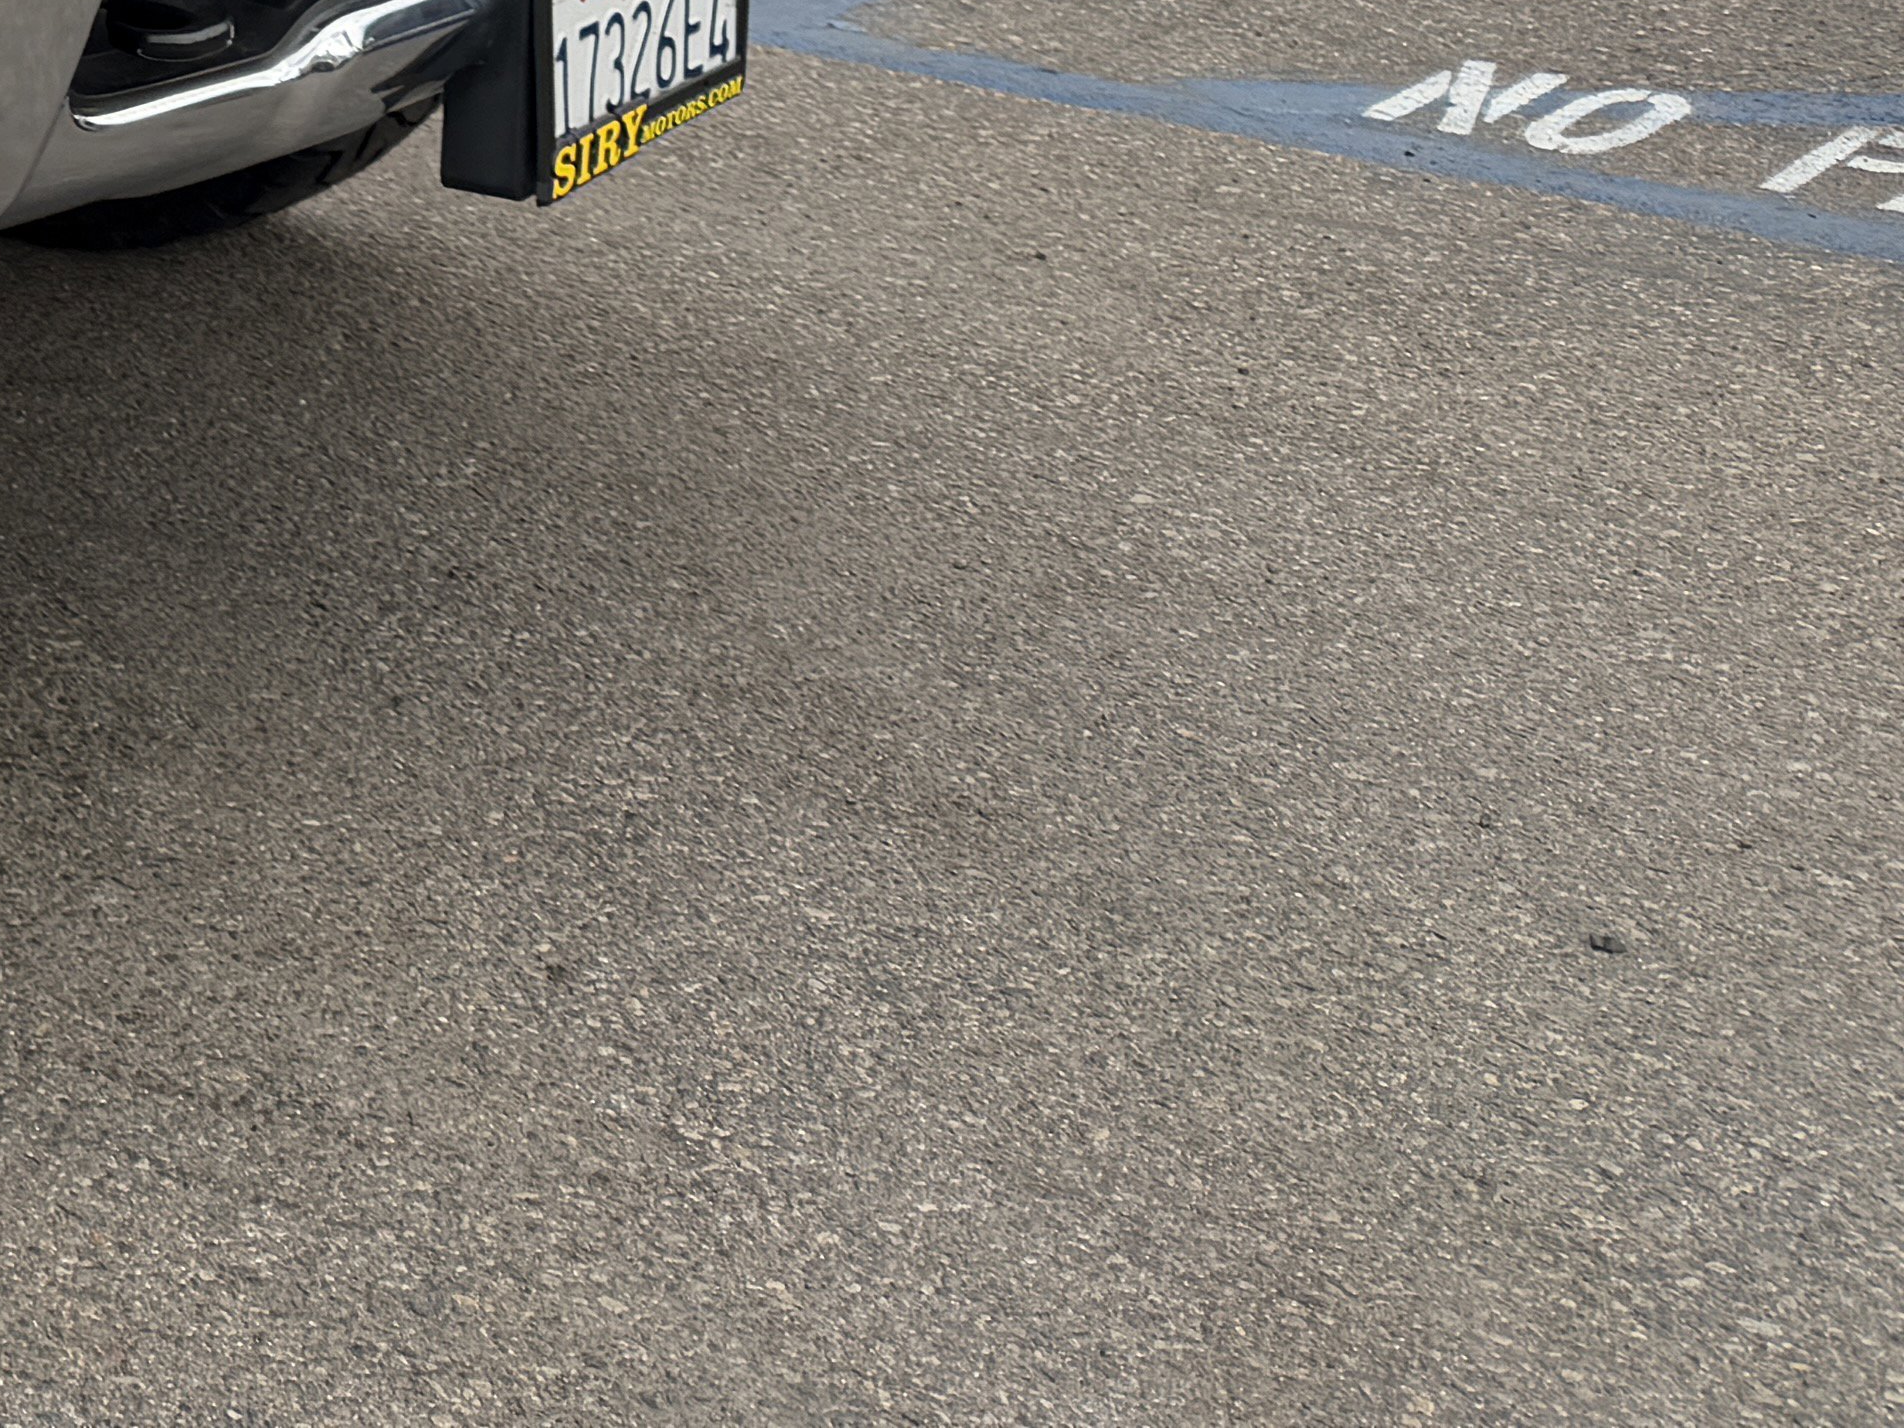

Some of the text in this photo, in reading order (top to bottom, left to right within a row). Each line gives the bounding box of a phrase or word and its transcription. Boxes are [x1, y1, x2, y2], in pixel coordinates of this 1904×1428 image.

[552, 76, 743, 199] SIRY MOTORS.COM
[1361, 60, 1692, 155] NO
